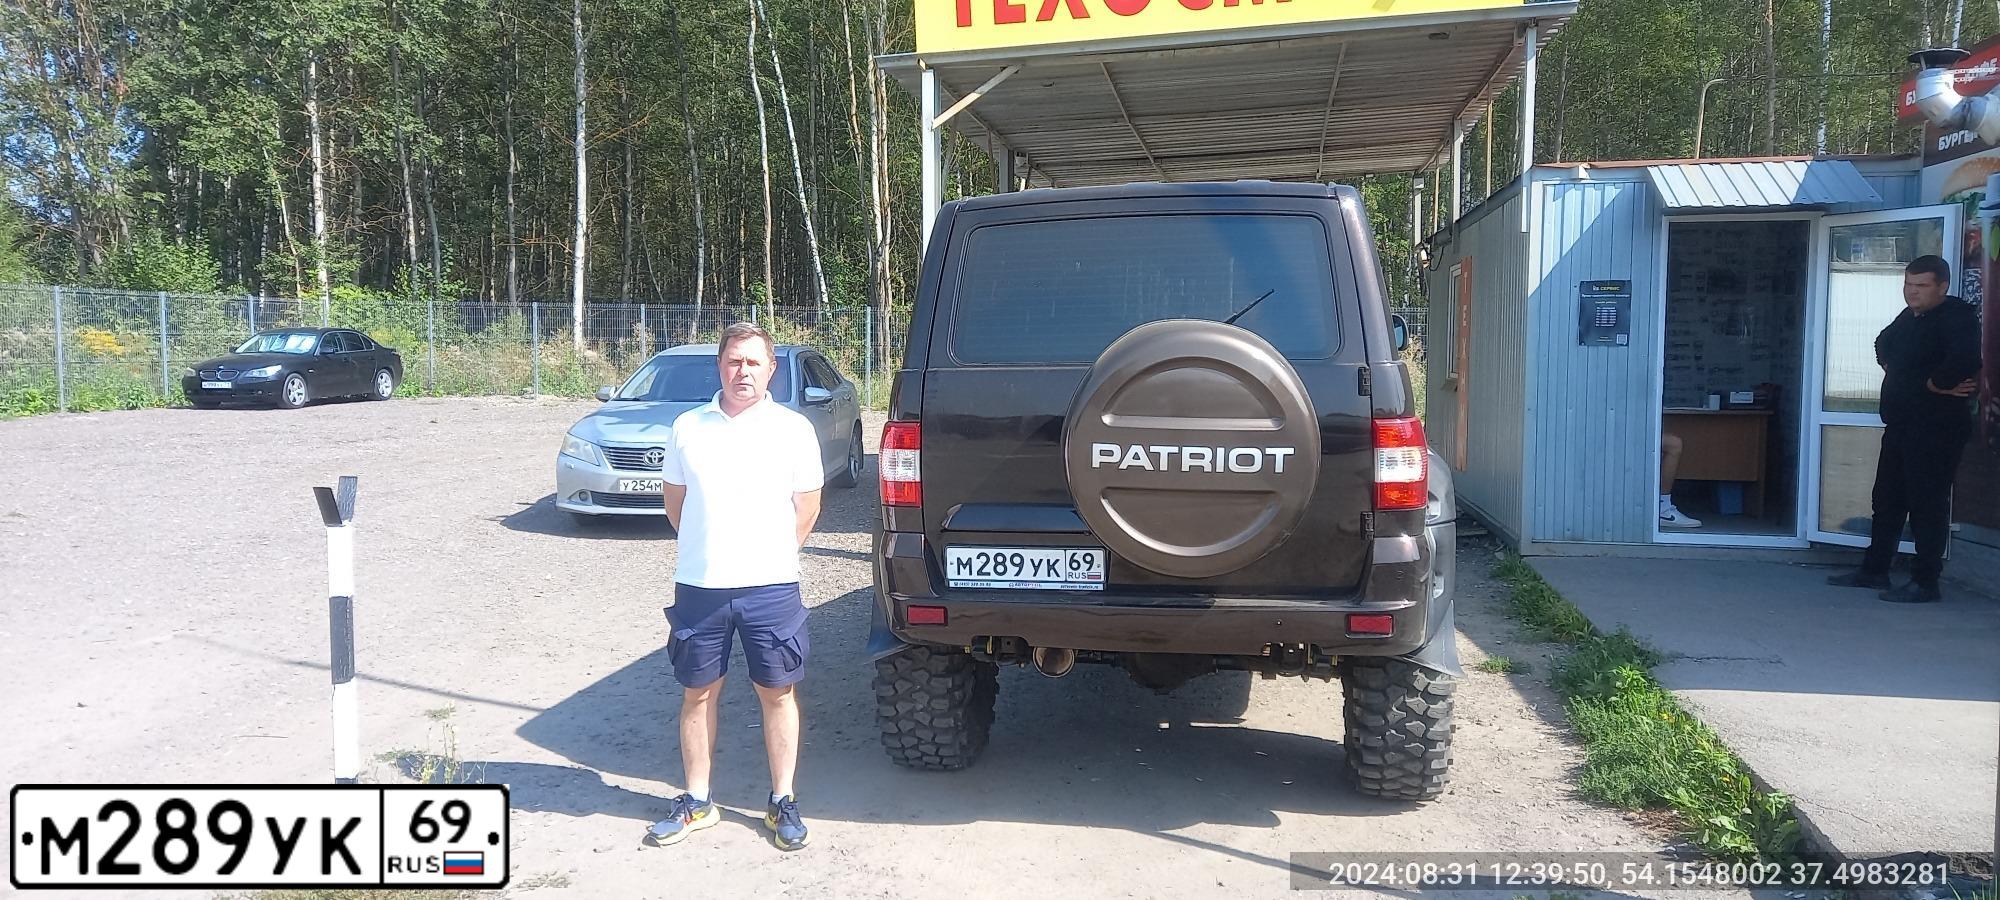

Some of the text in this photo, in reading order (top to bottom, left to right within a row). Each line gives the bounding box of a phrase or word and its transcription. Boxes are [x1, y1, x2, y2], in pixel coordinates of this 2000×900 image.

[1091, 442, 1295, 474] PATRIOT
[956, 552, 1095, 577] М289УК 69
[1068, 571, 1087, 580] RUS
